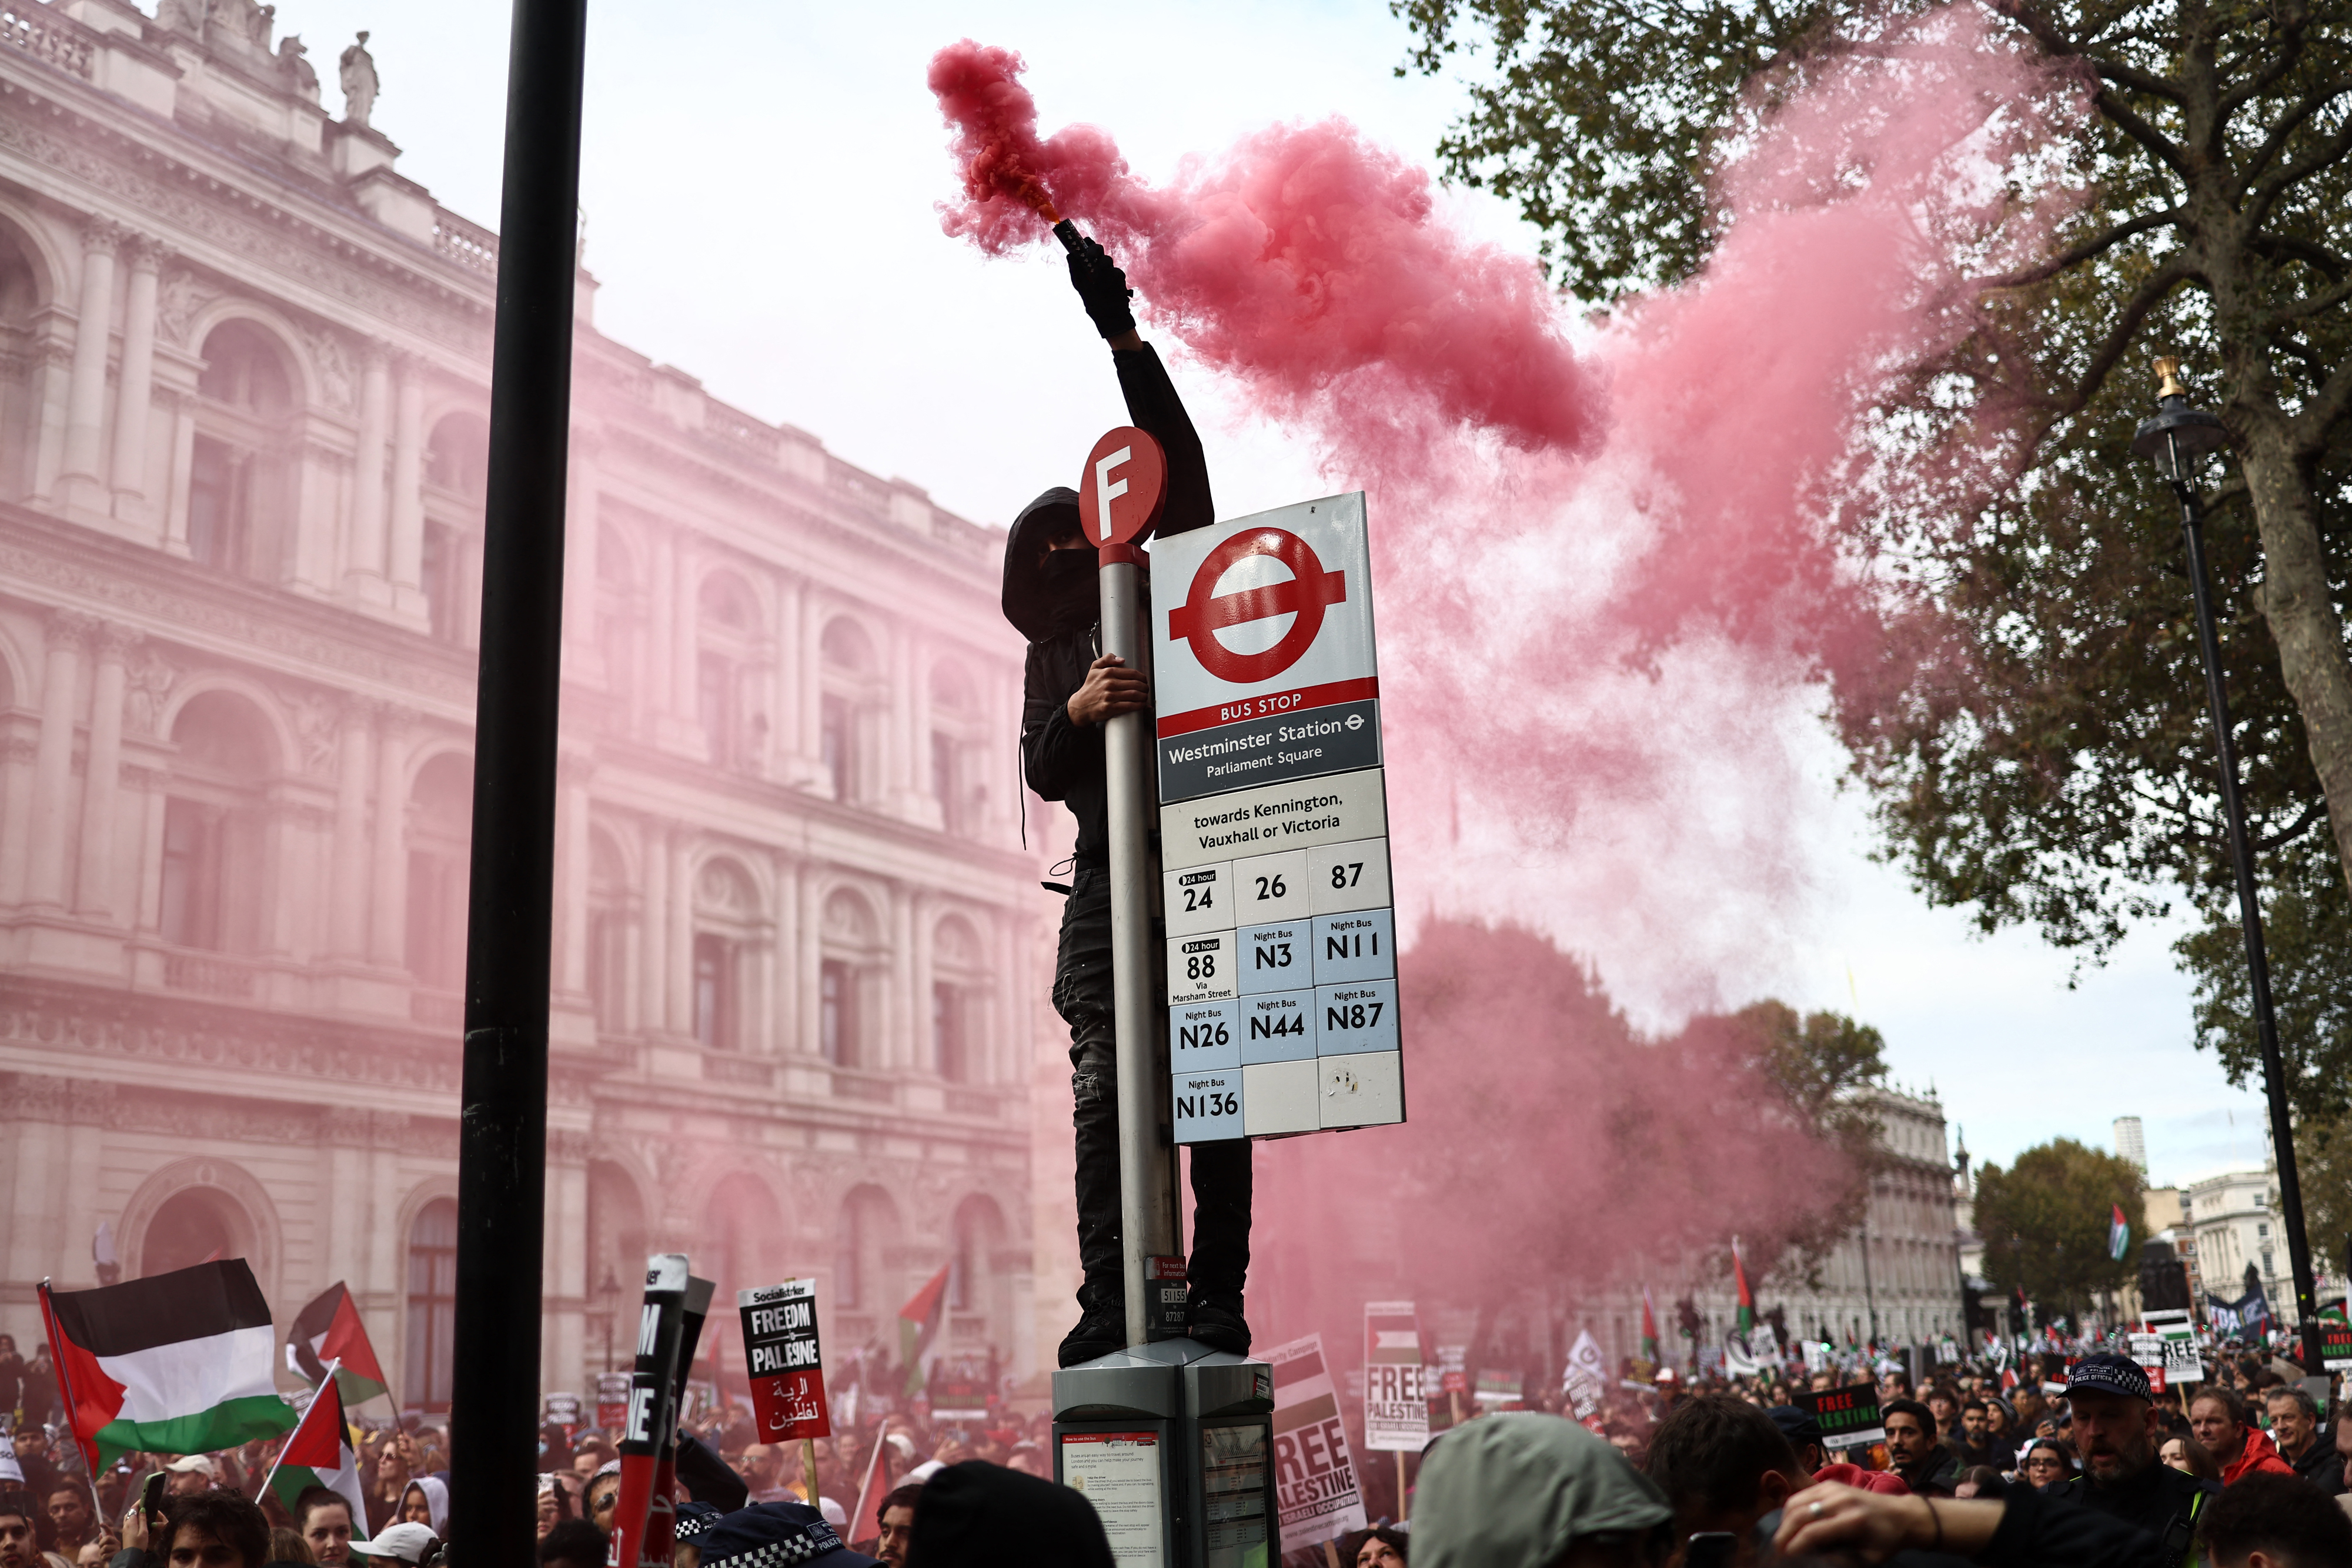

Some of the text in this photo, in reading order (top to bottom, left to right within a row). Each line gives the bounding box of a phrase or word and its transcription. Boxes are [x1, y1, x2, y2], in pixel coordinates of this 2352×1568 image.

[1096, 445, 1131, 541] F
[1221, 693, 1302, 721] BUS STOP
[1169, 718, 1341, 764] Westminster Station
[1207, 747, 1322, 777] Parliament Square
[1194, 794, 1343, 829] towards Kennington,
[1199, 816, 1340, 849] Vauxhall or Victoria
[1187, 872, 1215, 883] 24 hour
[1256, 874, 1286, 900] 26
[1332, 862, 1363, 889] 87
[1184, 886, 1212, 912] 24
[1254, 930, 1292, 941] Night Bus
[1331, 919, 1372, 931] Night Bus
[1190, 941, 1218, 952] 24 hour
[1256, 943, 1292, 970] N3
[1327, 932, 1378, 960] N11
[1187, 954, 1215, 980] 88
[1173, 989, 1231, 1002] Marsham Street
[1257, 1001, 1278, 1011] Night
[1334, 990, 1376, 1002] Night Bus
[1186, 1011, 1205, 1021] Night
[1251, 1012, 1304, 1040] N44
[1327, 1002, 1384, 1031] N87
[1180, 1022, 1229, 1050] N26
[1189, 1080, 1207, 1090] Night
[1177, 1092, 1238, 1119] N136
[1164, 1291, 1185, 1301] 51155
[1166, 1312, 1184, 1322] 87287
[1288, 1341, 1317, 1357] Campaign
[2162, 1341, 2194, 1358] REE
[1368, 1367, 1424, 1401] FREE
[1367, 1402, 1426, 1420] PALESTINE
[1817, 1393, 1853, 1413] FREE
[1816, 1405, 1879, 1429] LESTINE
[1274, 1418, 1348, 1485] REE
[1277, 1467, 1354, 1510] ALESTINE
[1283, 1507, 1316, 1524] ISRAELI
[818, 1537, 838, 1551] POLICE
